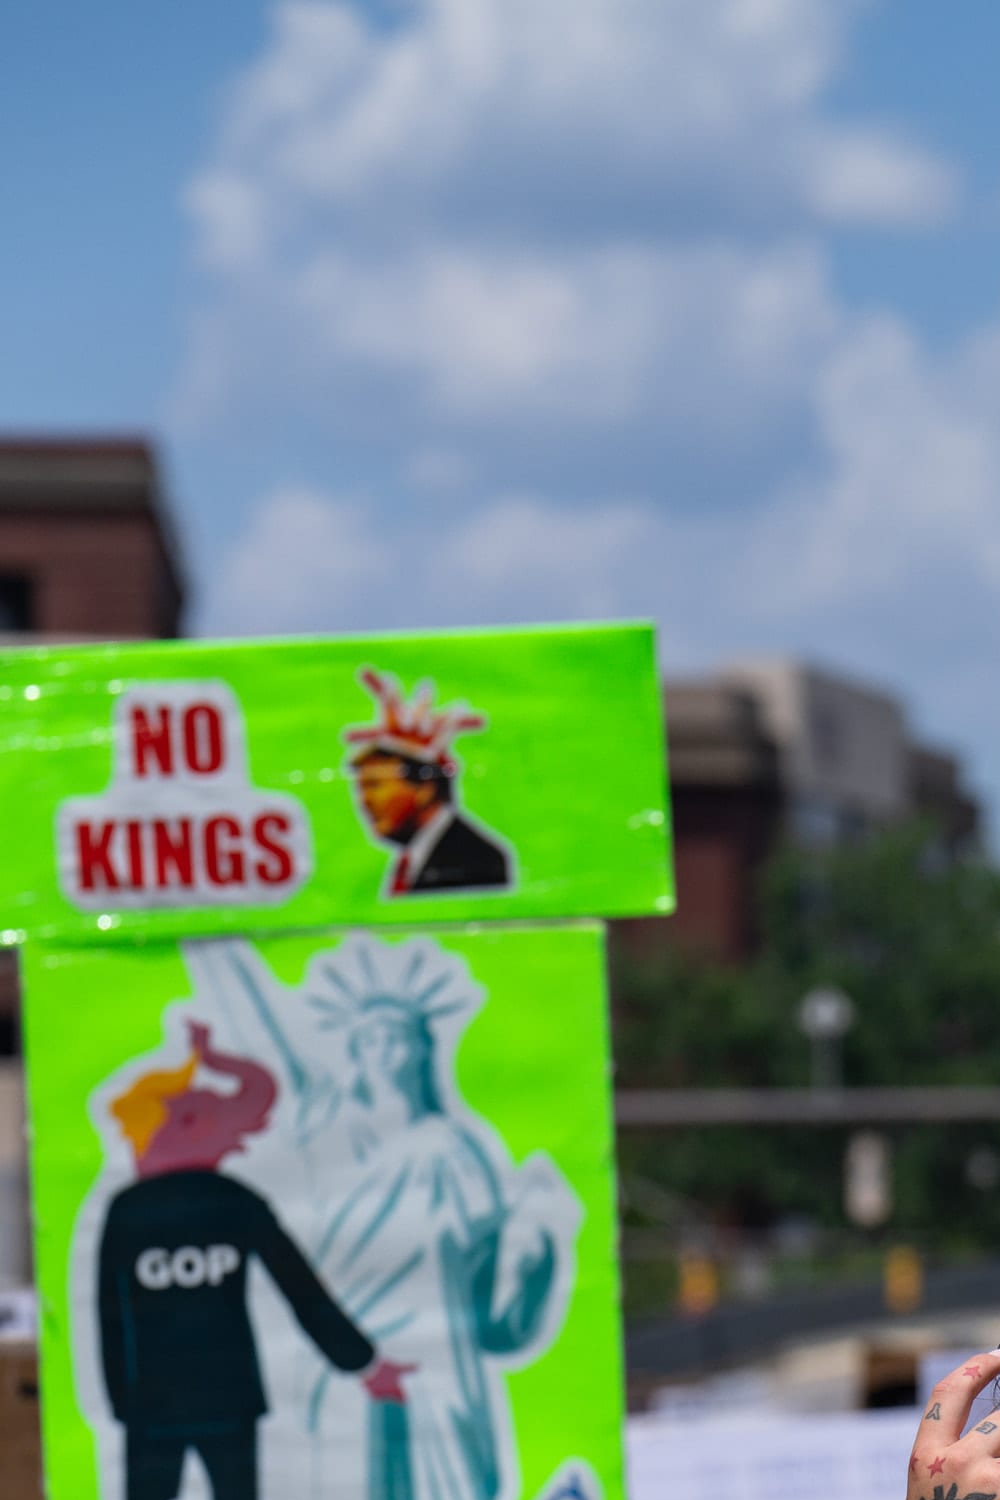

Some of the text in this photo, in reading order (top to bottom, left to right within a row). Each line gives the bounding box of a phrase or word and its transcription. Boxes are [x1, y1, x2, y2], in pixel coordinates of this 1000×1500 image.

[130, 701, 225, 779] NO
[76, 810, 292, 892] KINGS
[135, 1243, 240, 1290] GOP
